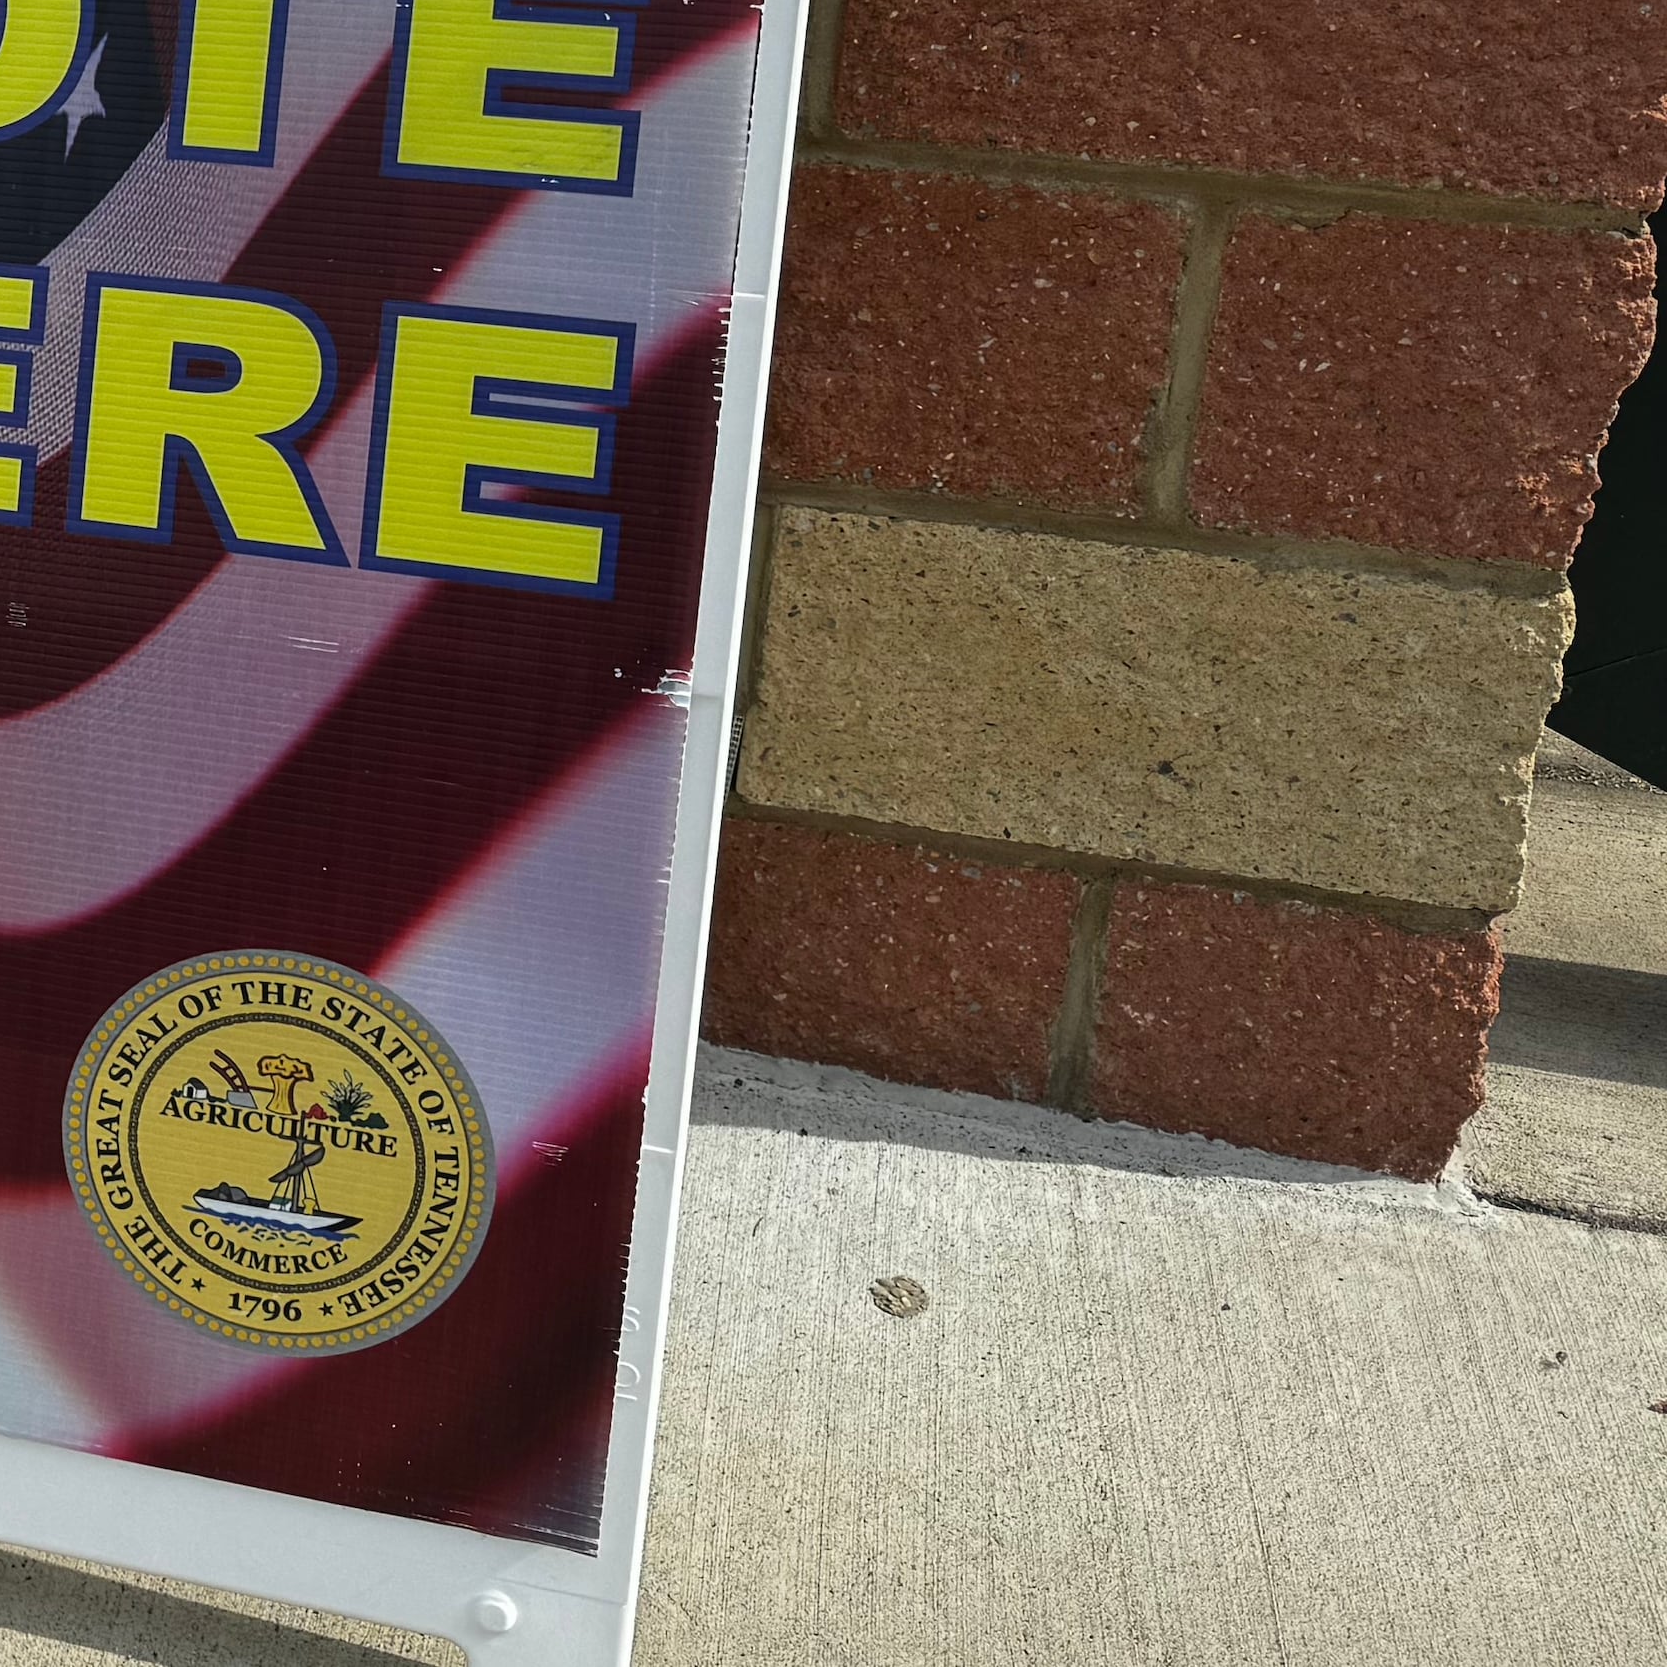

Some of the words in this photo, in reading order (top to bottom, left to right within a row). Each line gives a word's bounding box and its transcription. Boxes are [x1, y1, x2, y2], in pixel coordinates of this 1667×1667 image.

[178, 985, 227, 1020] OF
[231, 980, 314, 1013] THE
[109, 1011, 179, 1089] SEAL
[320, 996, 429, 1088] STATE
[159, 1095, 398, 1159] AGRICULTURE
[417, 1089, 456, 1137] OF
[96, 1089, 135, 1211] GREAT
[125, 1214, 195, 1285] THE
[188, 1217, 350, 1275] COMMERCE
[336, 1145, 461, 1318] TENNESSEE
[227, 1290, 303, 1323] 1796
